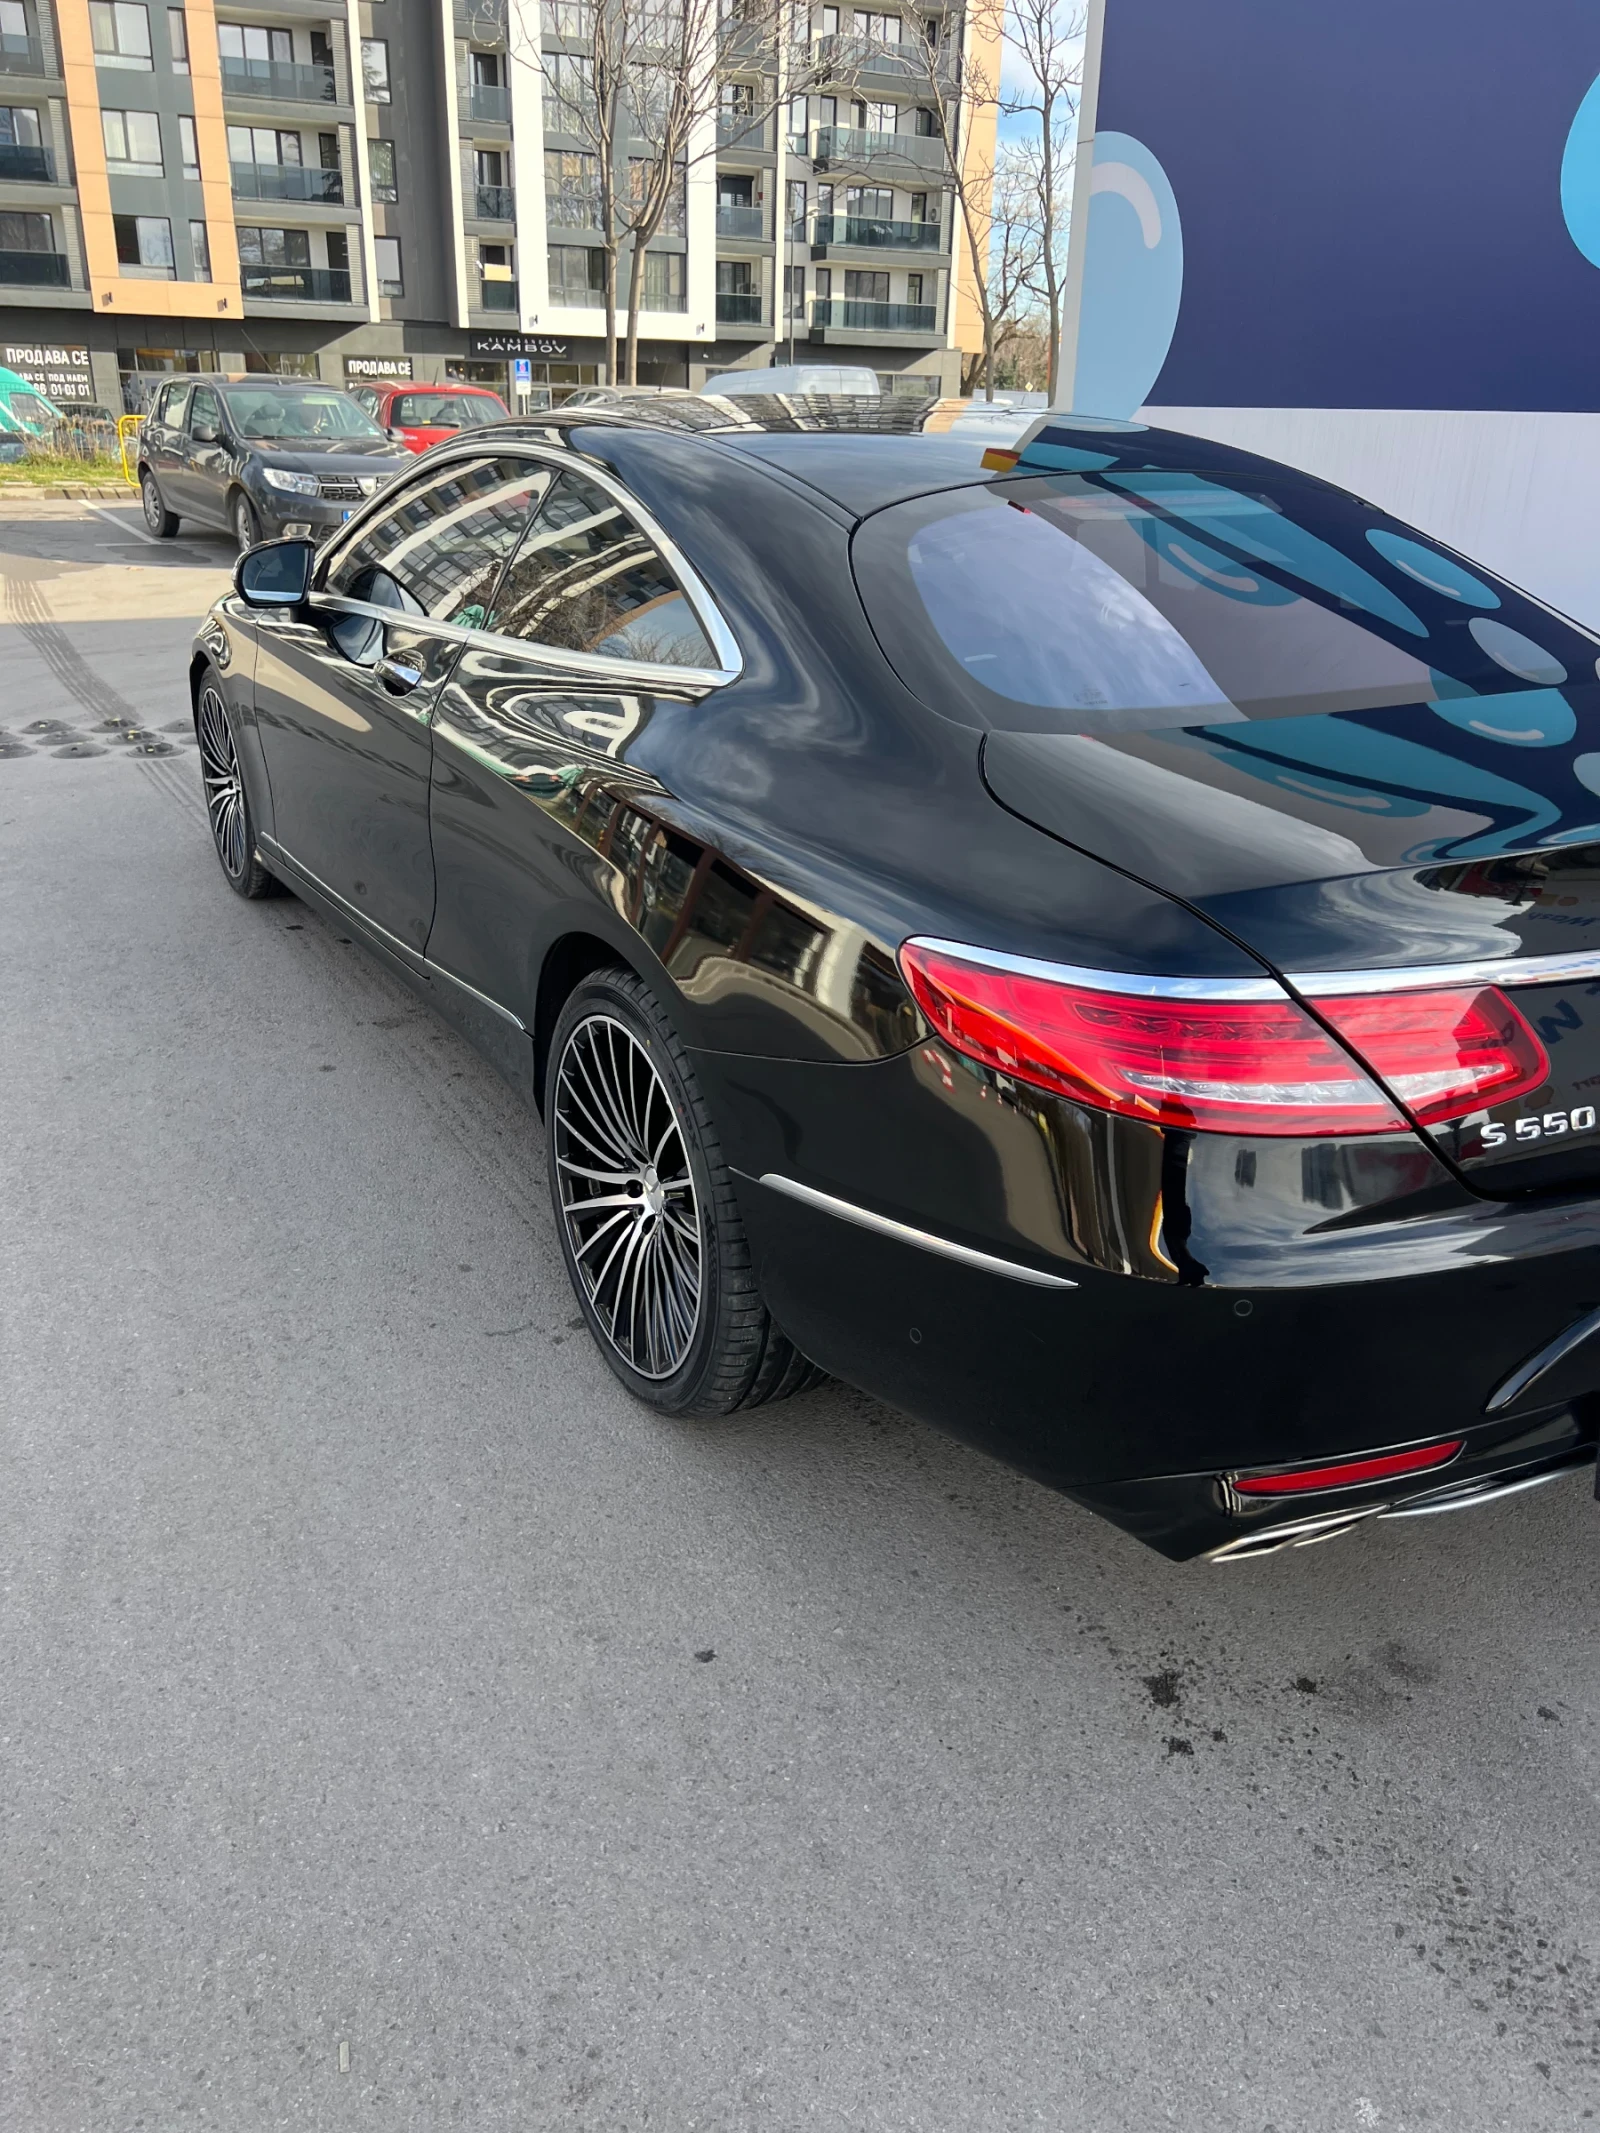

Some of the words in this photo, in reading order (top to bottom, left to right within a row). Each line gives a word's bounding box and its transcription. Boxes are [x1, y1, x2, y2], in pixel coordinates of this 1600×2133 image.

[477, 342, 566, 353] KAMBOV
[6, 348, 70, 366] ПРОДАВА
[72, 351, 90, 365] СЕ
[348, 360, 397, 375] ПРОДАВА
[398, 362, 411, 375] СЕ
[18, 372, 33, 381] АВА
[34, 373, 45, 381] СЕ
[48, 374, 65, 383] ПОД
[66, 374, 88, 382] НАЕМ
[50, 383, 63, 395] 01
[64, 384, 76, 396] 01
[78, 384, 90, 396] 01
[1480, 1122, 1507, 1148] S
[1515, 1106, 1596, 1141] 550
